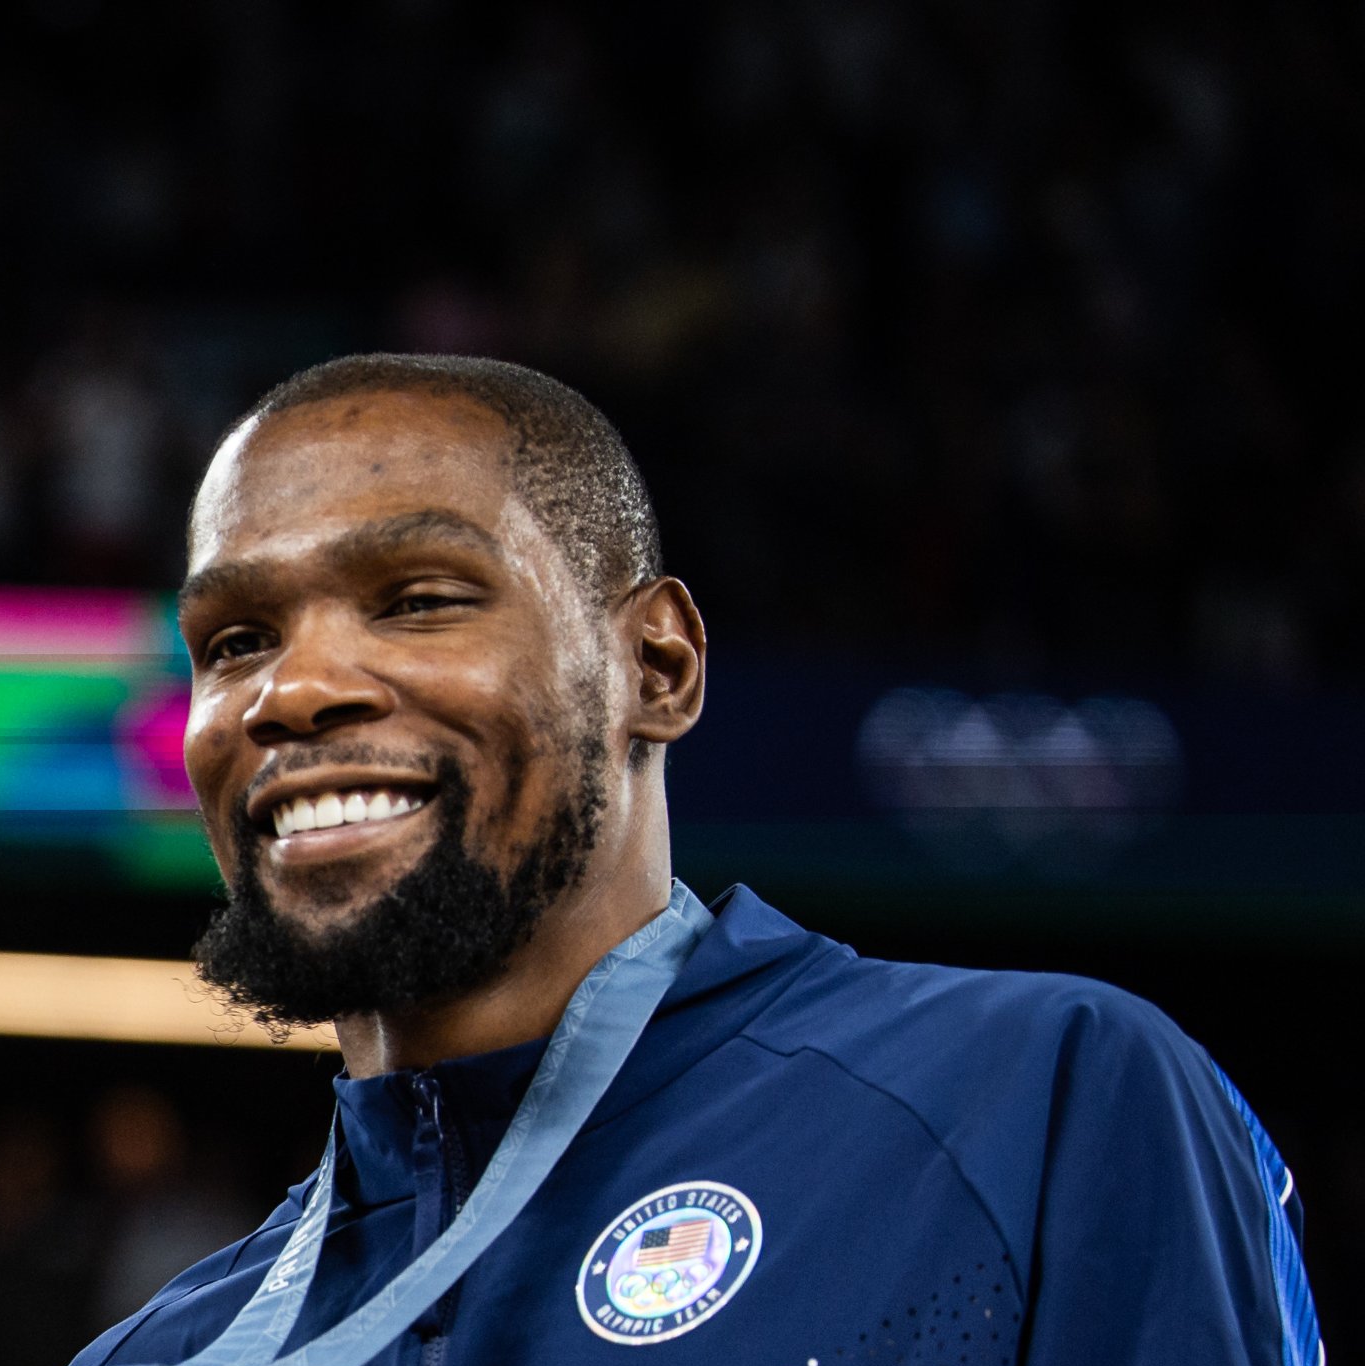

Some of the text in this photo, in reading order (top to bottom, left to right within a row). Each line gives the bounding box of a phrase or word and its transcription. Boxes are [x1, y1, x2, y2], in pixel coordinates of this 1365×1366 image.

[611, 1191, 743, 1241] UNITED STATES
[595, 1287, 722, 1334] OLYMPIC TEAM
